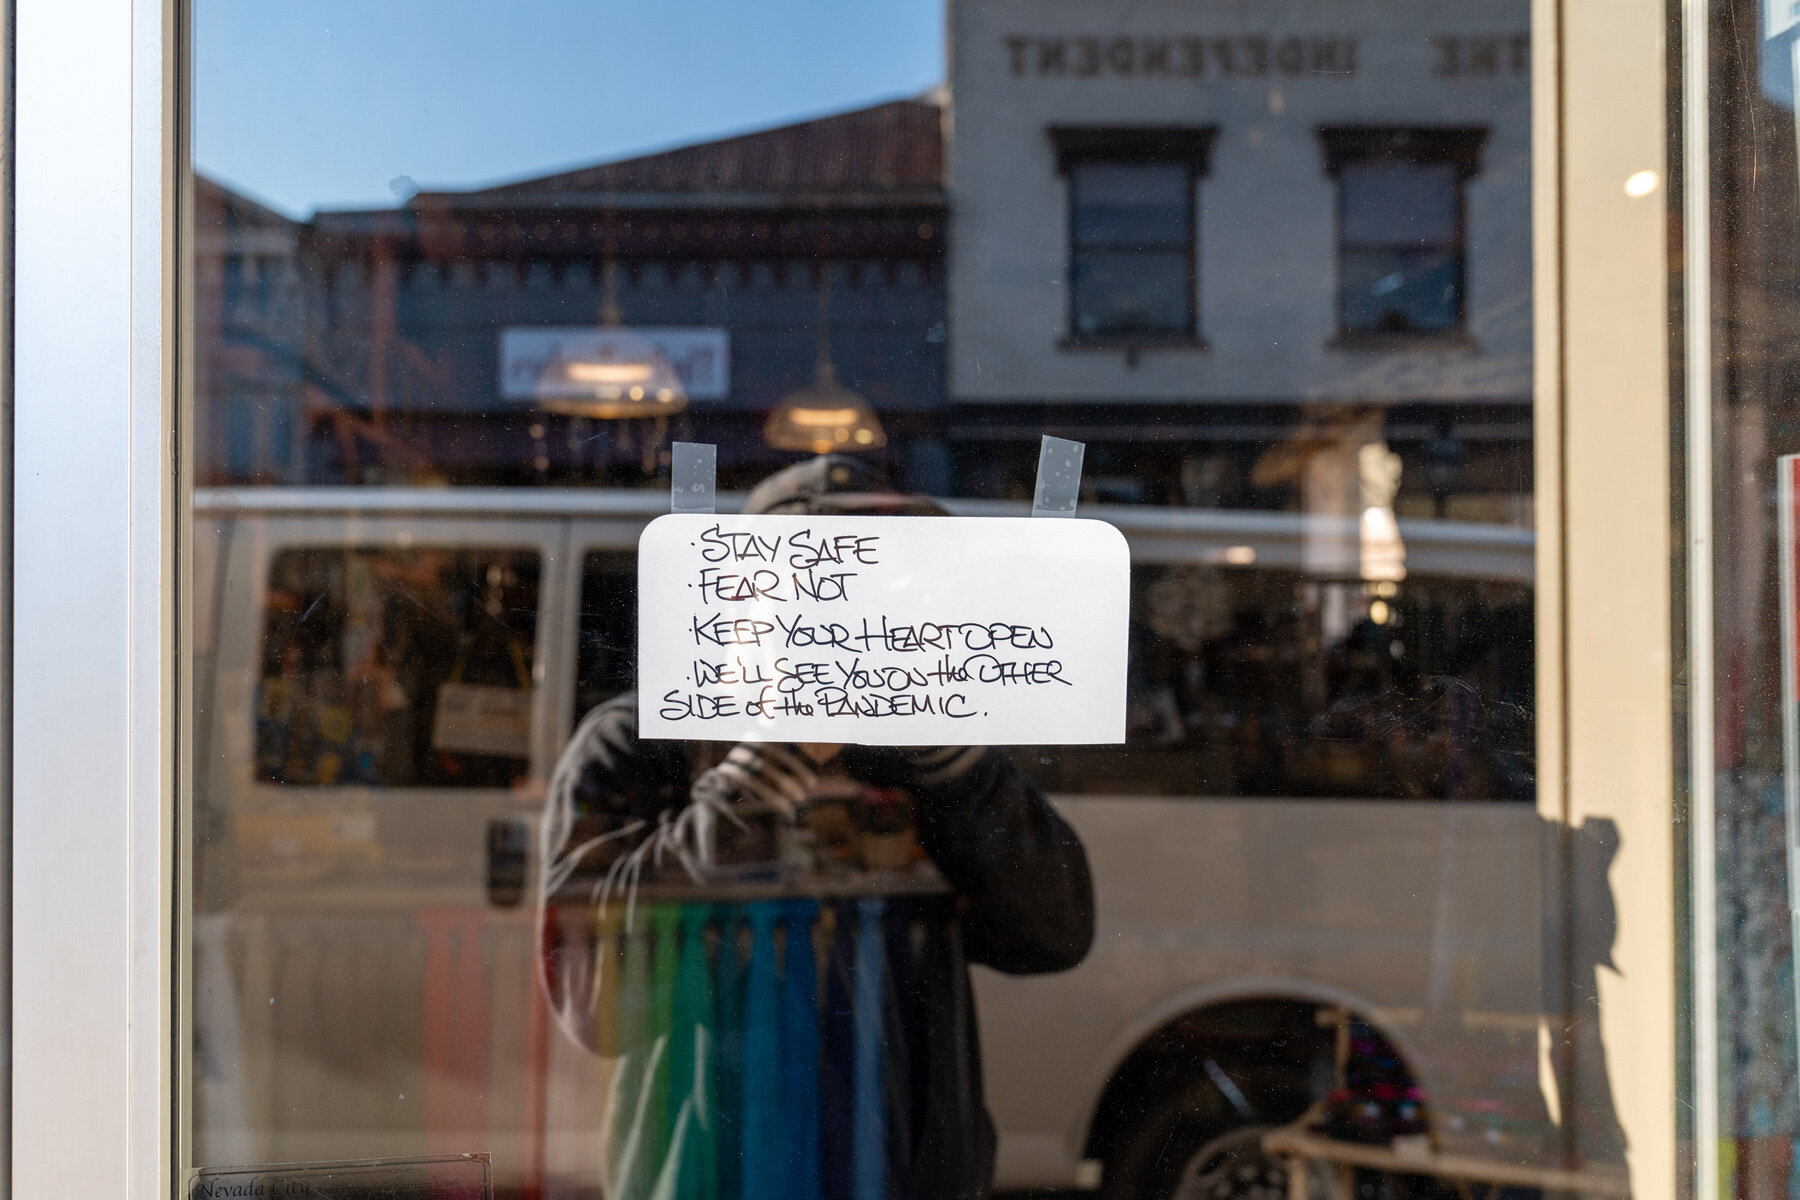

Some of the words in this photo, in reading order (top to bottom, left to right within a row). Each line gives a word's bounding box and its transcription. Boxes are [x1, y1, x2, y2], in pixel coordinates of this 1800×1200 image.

[700, 523, 782, 563] STAY
[788, 529, 880, 570] SAFE
[698, 567, 788, 605] FEAR
[791, 568, 858, 603] NOT
[693, 612, 775, 647] KEEP
[775, 613, 863, 653] YOUR
[854, 615, 958, 653] HEART
[958, 622, 1054, 651] OPEN
[693, 655, 774, 688] WE'LL
[774, 657, 835, 693] SEE
[881, 667, 929, 692] ON
[926, 654, 975, 687] the
[962, 654, 1073, 687] OTHER
[659, 689, 741, 721] SIDE
[745, 685, 777, 720] of
[772, 687, 815, 717] the
[813, 686, 989, 720] PANDEMIC.
[200, 1177, 266, 1199] Nevada
[270, 1177, 312, 1198] City
